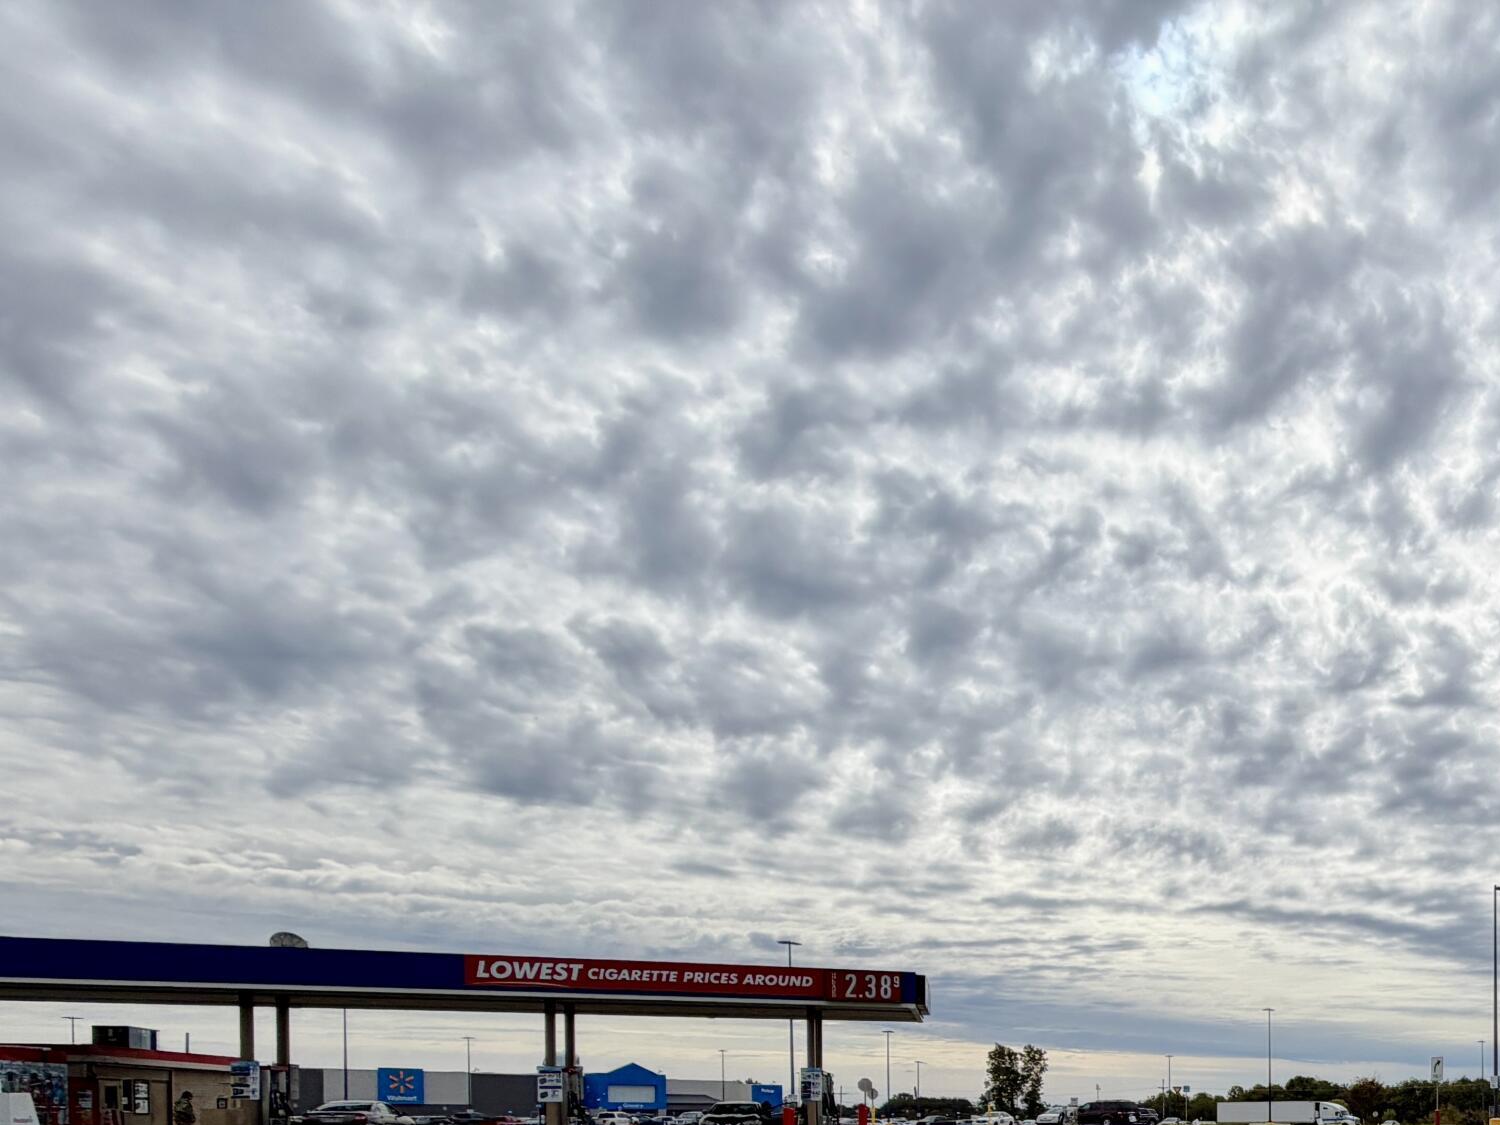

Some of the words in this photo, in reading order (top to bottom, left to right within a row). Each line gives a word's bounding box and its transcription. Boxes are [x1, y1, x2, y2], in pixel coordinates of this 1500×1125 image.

[476, 960, 584, 981] LOWEST
[588, 967, 678, 983] CIGARETTE
[683, 971, 738, 985] PRICES
[742, 974, 814, 988] AROUND
